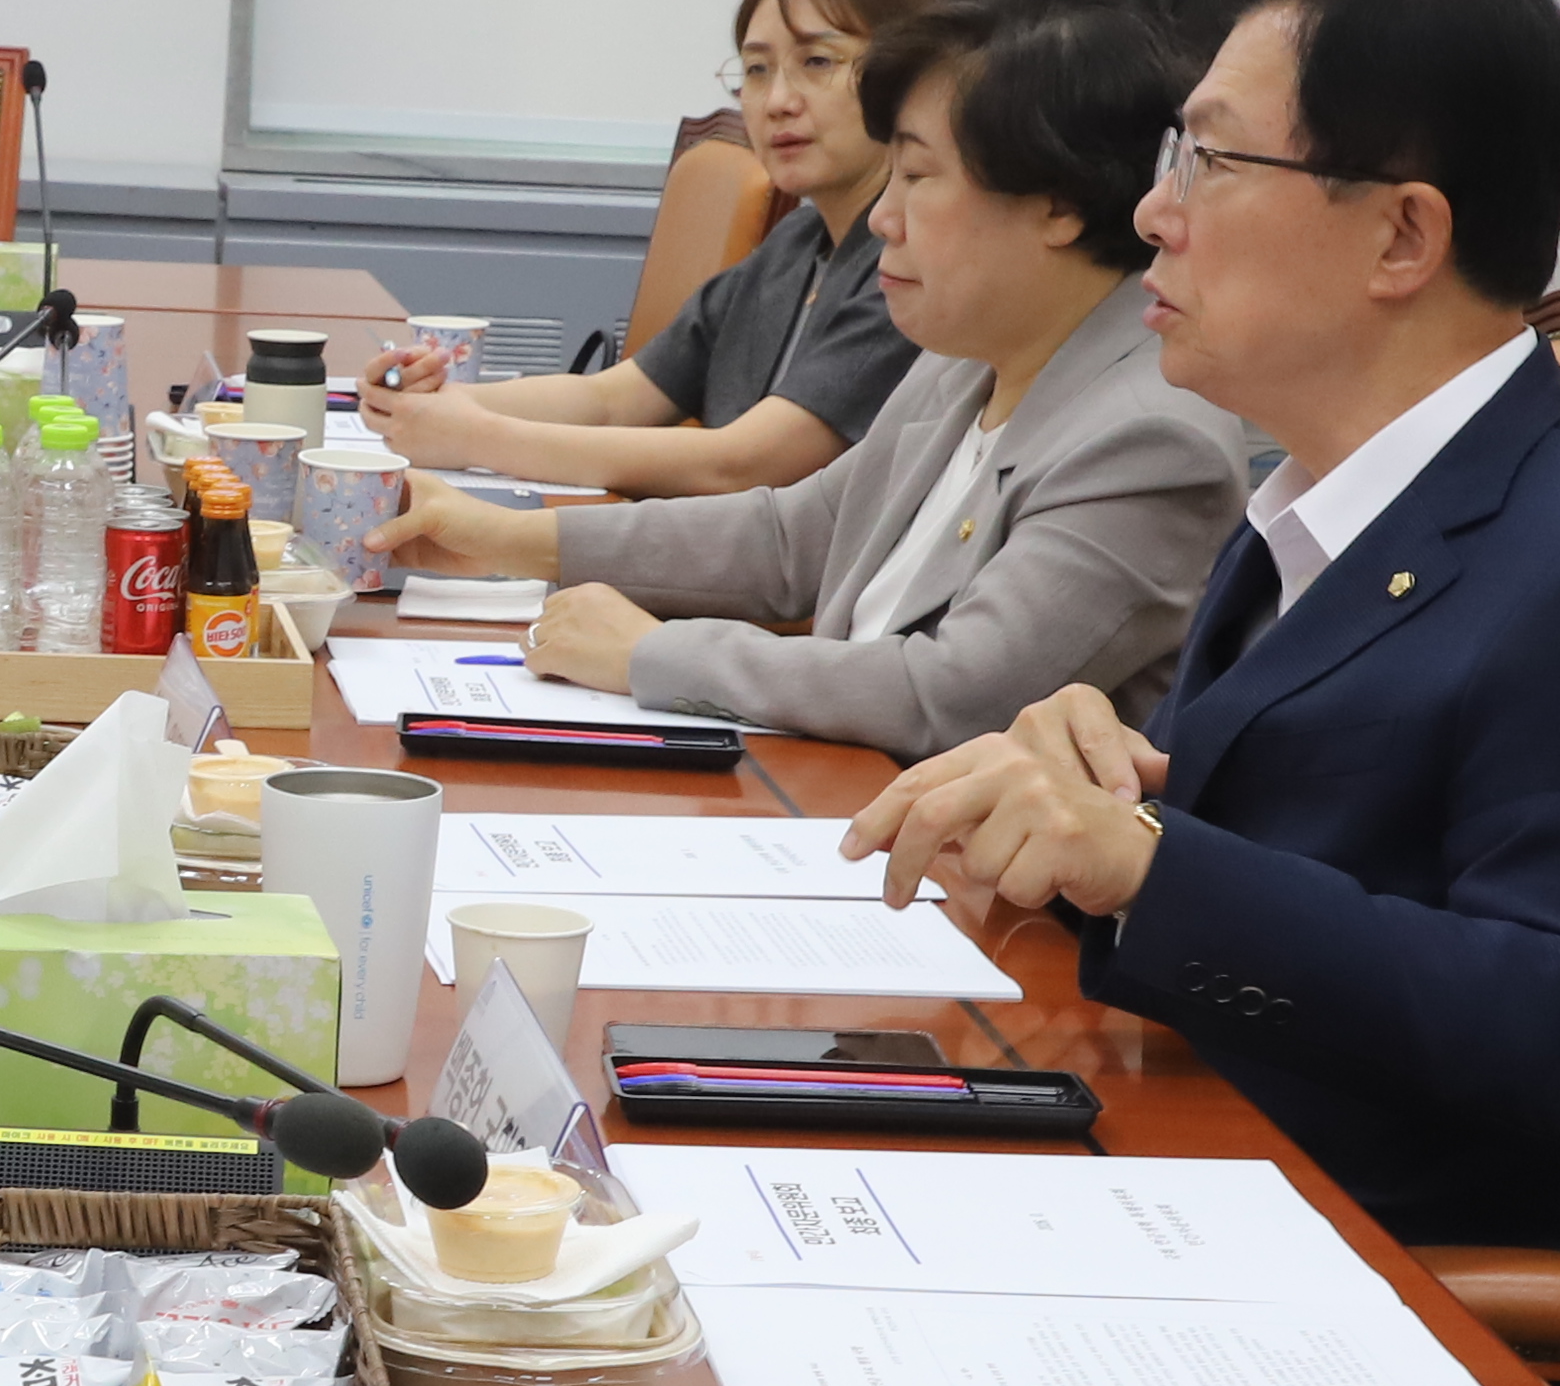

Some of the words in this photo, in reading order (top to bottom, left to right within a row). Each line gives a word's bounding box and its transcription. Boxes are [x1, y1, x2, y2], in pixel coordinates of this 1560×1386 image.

[362, 874, 375, 912] unicef
[359, 936, 373, 952] for
[354, 954, 368, 989] every
[353, 991, 367, 1020] child
[766, 1182, 841, 1245] 민간자문위원회
[828, 1195, 871, 1215] 보고
[840, 1216, 884, 1235] 최종
[197, 1253, 259, 1269] Ace
